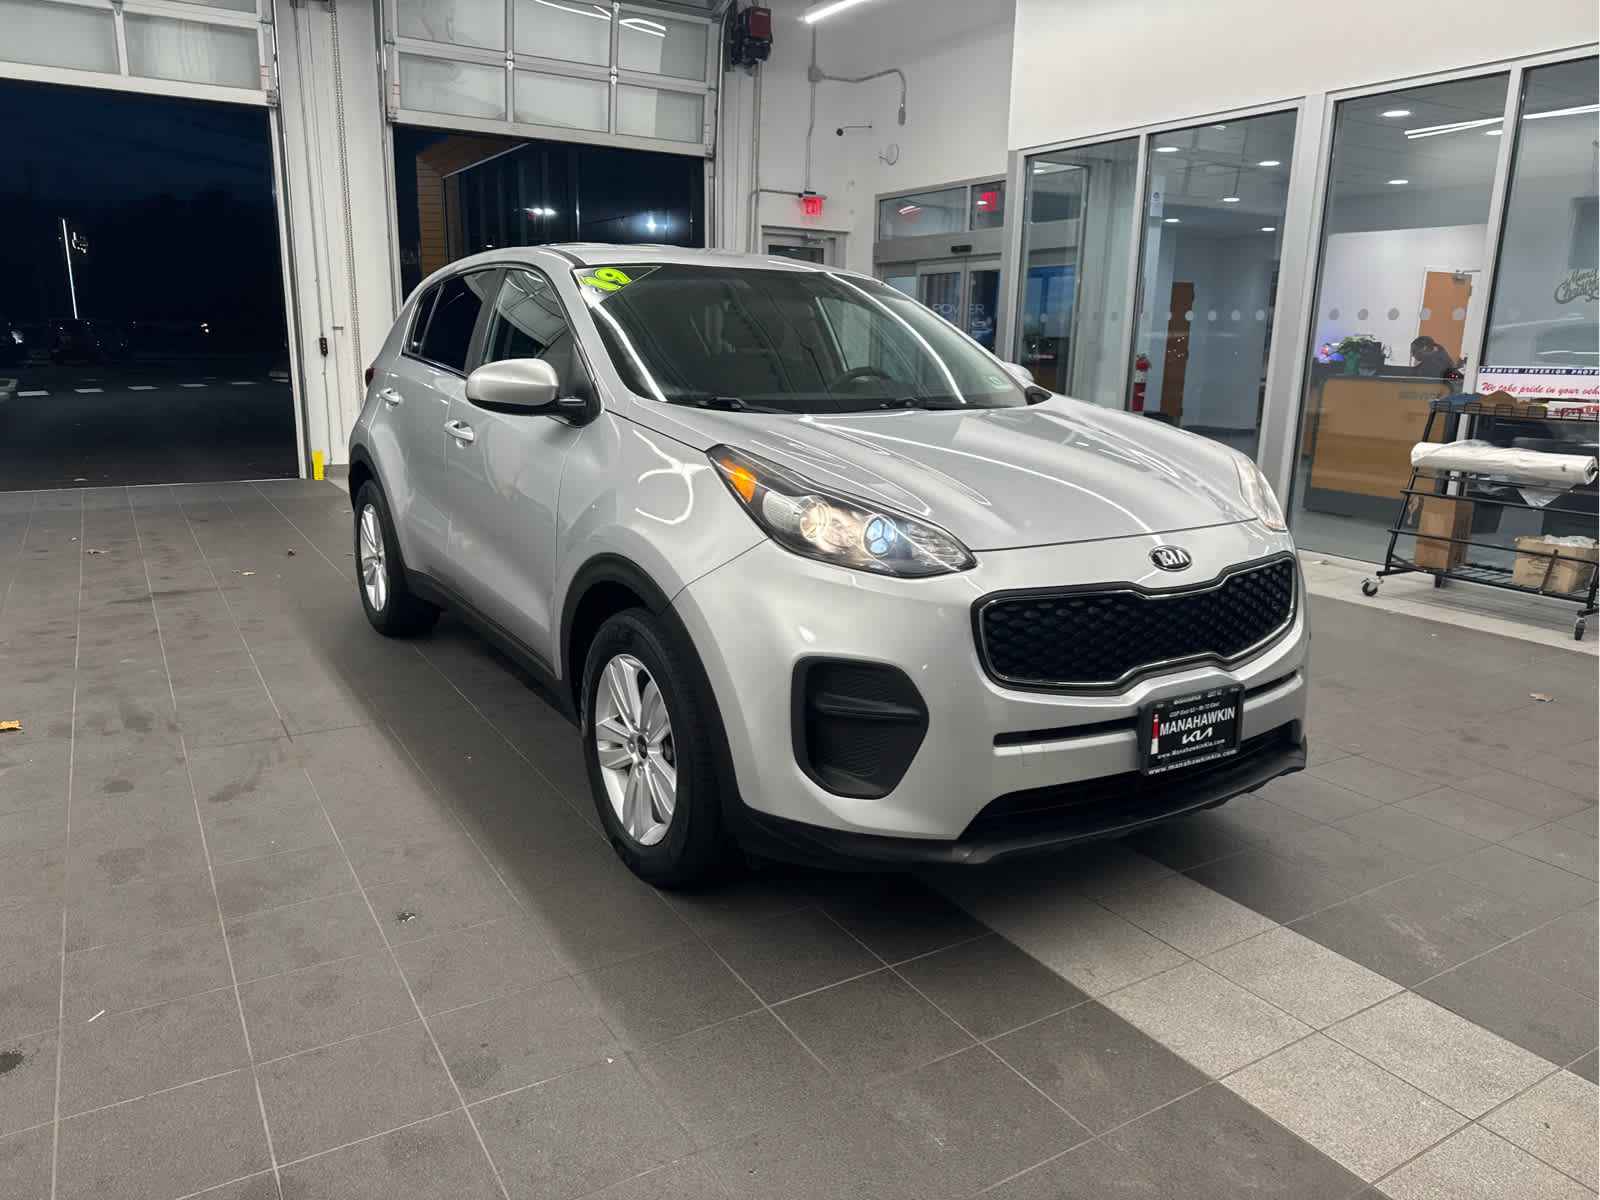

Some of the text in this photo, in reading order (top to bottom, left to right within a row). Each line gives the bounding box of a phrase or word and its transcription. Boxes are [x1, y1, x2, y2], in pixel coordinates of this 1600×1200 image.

[805, 197, 824, 216] EXIT
[583, 267, 633, 291] 19
[1480, 367, 1520, 375] PREMIUM
[1481, 381, 1496, 392] We
[1498, 383, 1518, 392] take
[1518, 384, 1545, 395] pride
[1546, 385, 1556, 394] in
[1558, 387, 1579, 396] your
[1154, 549, 1190, 566] KIA
[1159, 706, 1236, 737] MANAHAWKIN
